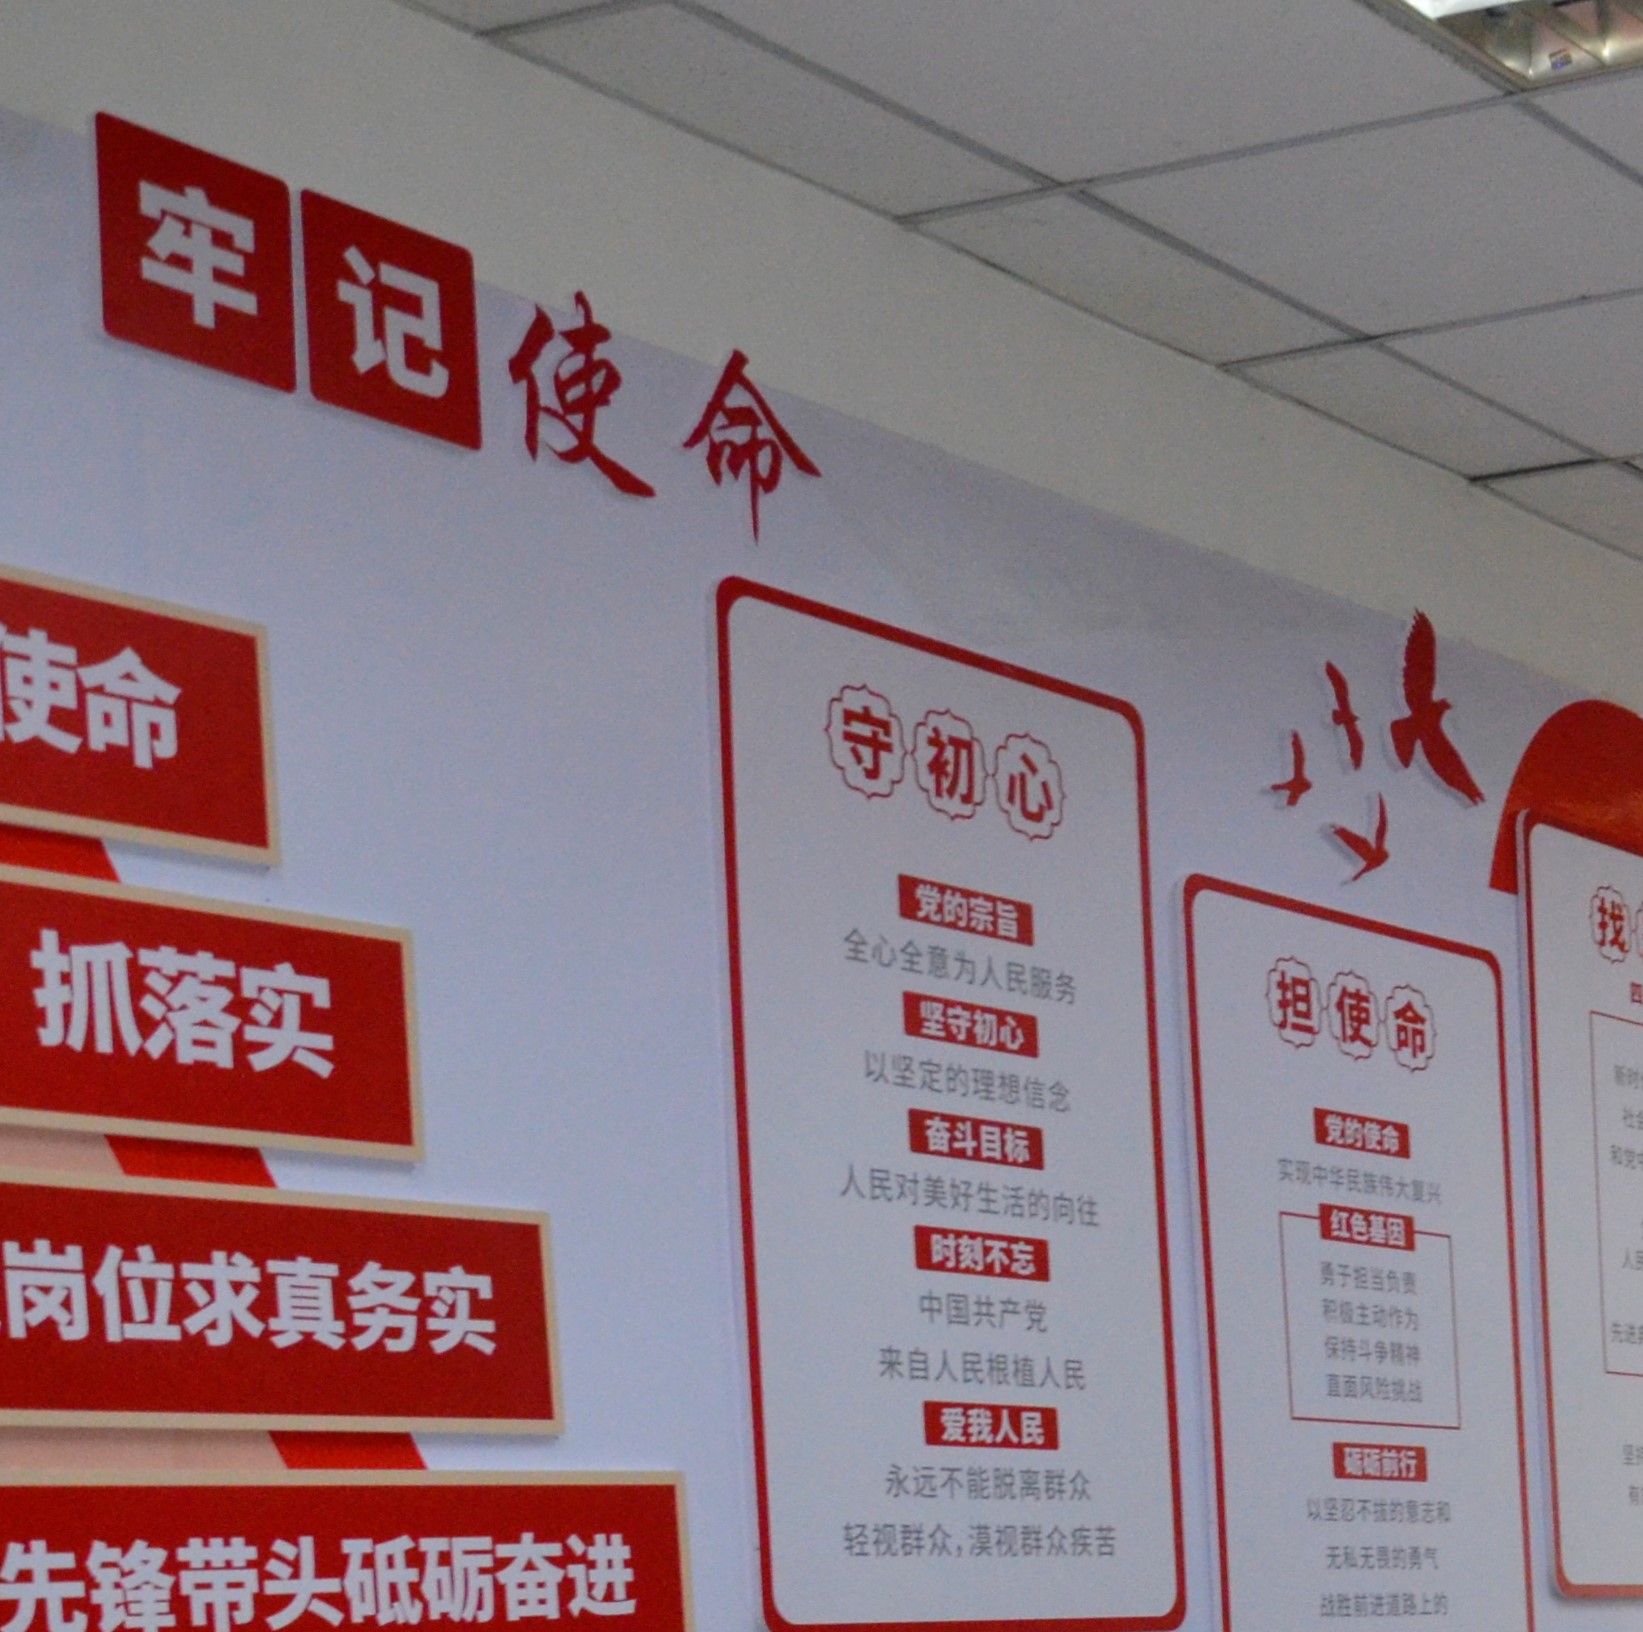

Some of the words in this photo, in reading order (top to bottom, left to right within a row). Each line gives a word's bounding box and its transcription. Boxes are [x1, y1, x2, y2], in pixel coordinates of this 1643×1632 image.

[139, 180, 822, 546] 牢记使命
[0, 621, 182, 769] 使命
[841, 705, 1054, 823] 守初心
[913, 883, 1020, 940] 党的宗旨
[842, 927, 1078, 1005] 全心全意为人民服务
[30, 928, 337, 1078] 抓落实
[919, 1001, 1026, 1052] 坚守初心
[1276, 970, 1427, 1059] 担使命
[863, 1048, 1073, 1113] 以坚定的理想信念
[925, 1117, 1031, 1164] 奋斗目标
[1324, 1113, 1400, 1153] 党的使命
[840, 1165, 1100, 1226] 人民对美好生活的向往
[1277, 1157, 1442, 1204] 实现中华民族伟大复兴
[1330, 1209, 1406, 1247] 红色基因
[929, 1233, 1037, 1276] 时刻不忘
[2, 1238, 497, 1356] 岗位求真务实
[918, 1290, 1049, 1332] 中国共产党
[1321, 1297, 1419, 1332] 积极主动作为
[878, 1346, 1087, 1391] 来自人民根植人民
[1324, 1335, 1421, 1367] 保持斗争精神
[1325, 1373, 1423, 1403] 直面风险挑战
[939, 1406, 1047, 1445] 爱我人民
[885, 1463, 1092, 1502] 永远不能脱离群众
[1326, 1545, 1440, 1570] 无私无畏的勇气
[1320, 1591, 1449, 1618] 战胜前进道路上的
